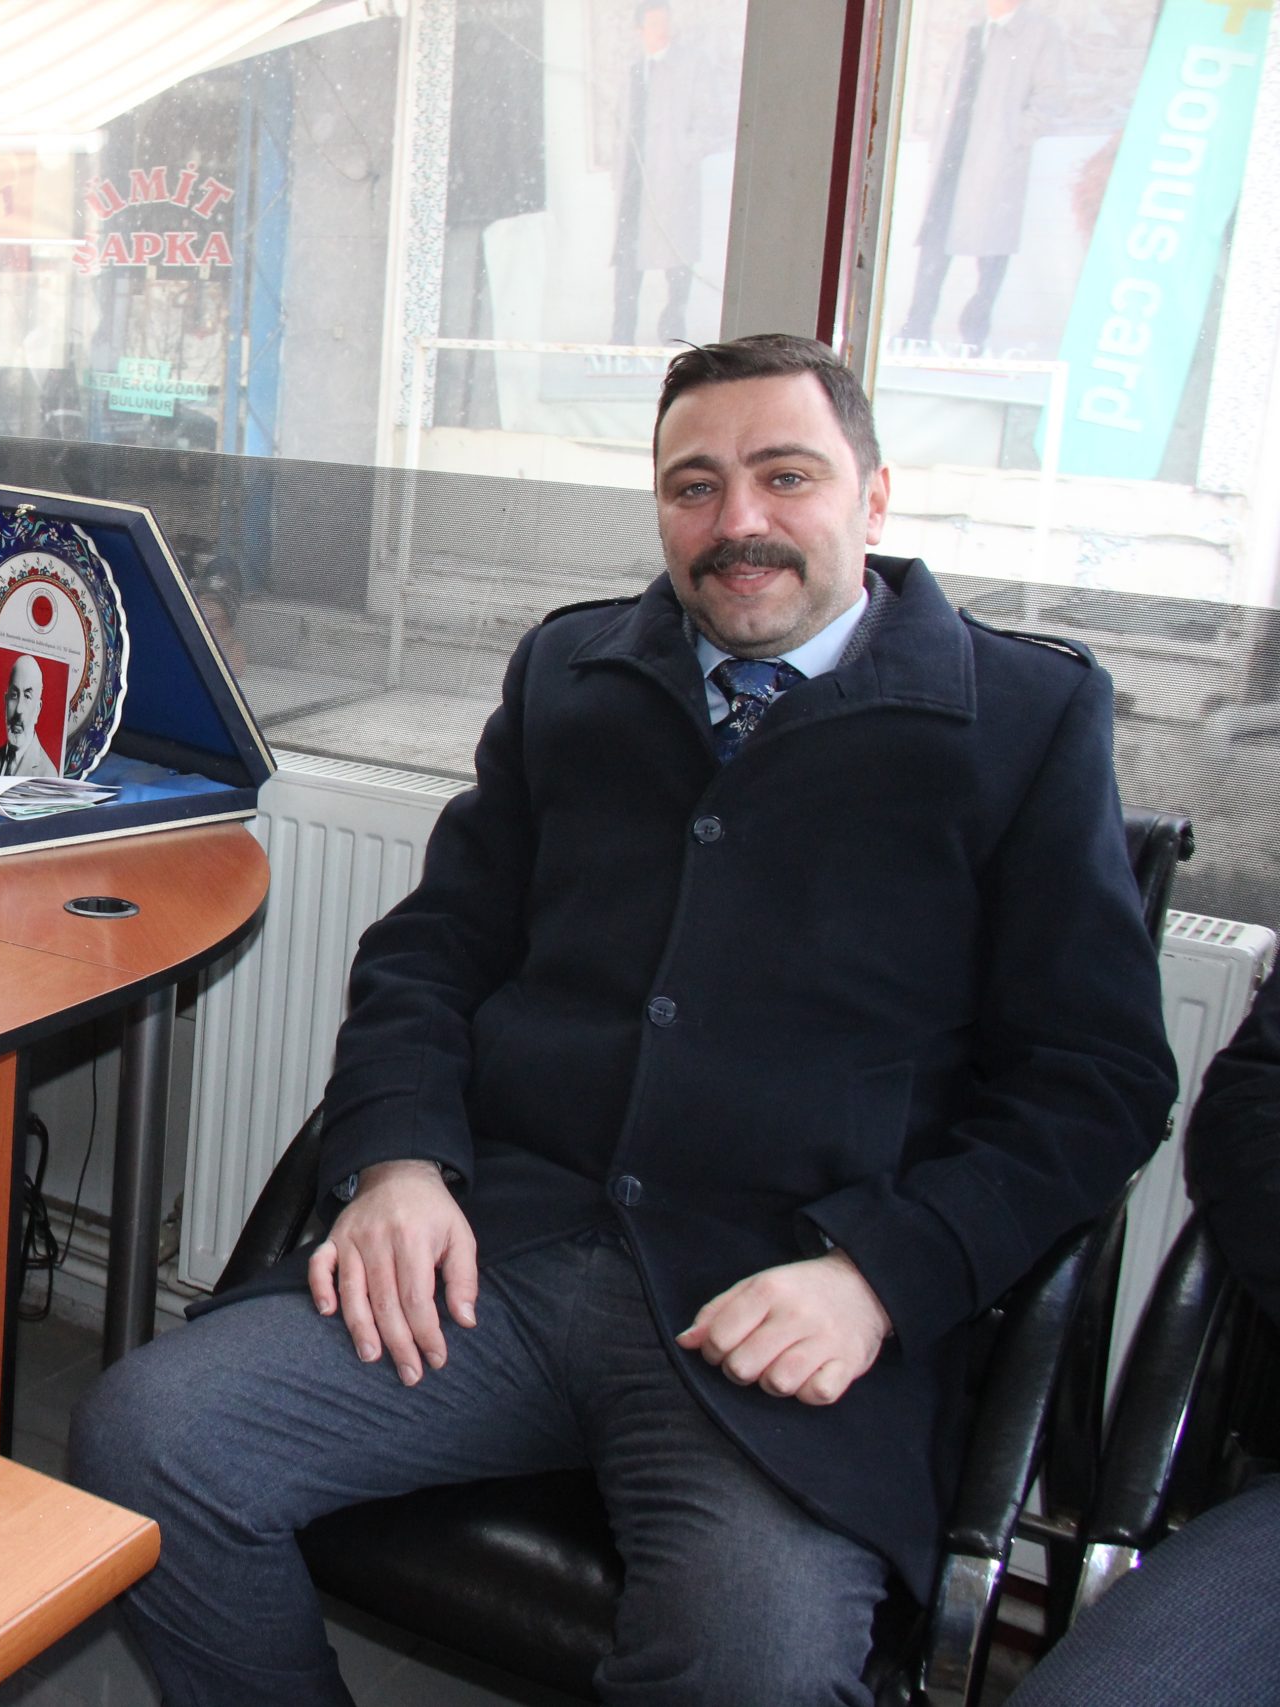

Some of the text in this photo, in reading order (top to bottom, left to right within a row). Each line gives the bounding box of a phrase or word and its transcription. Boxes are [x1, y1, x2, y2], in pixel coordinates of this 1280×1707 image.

[86, 161, 234, 221] ÜMİT
[72, 232, 233, 274] ŞAPKA
[1076, 44, 1256, 432] bonus card
